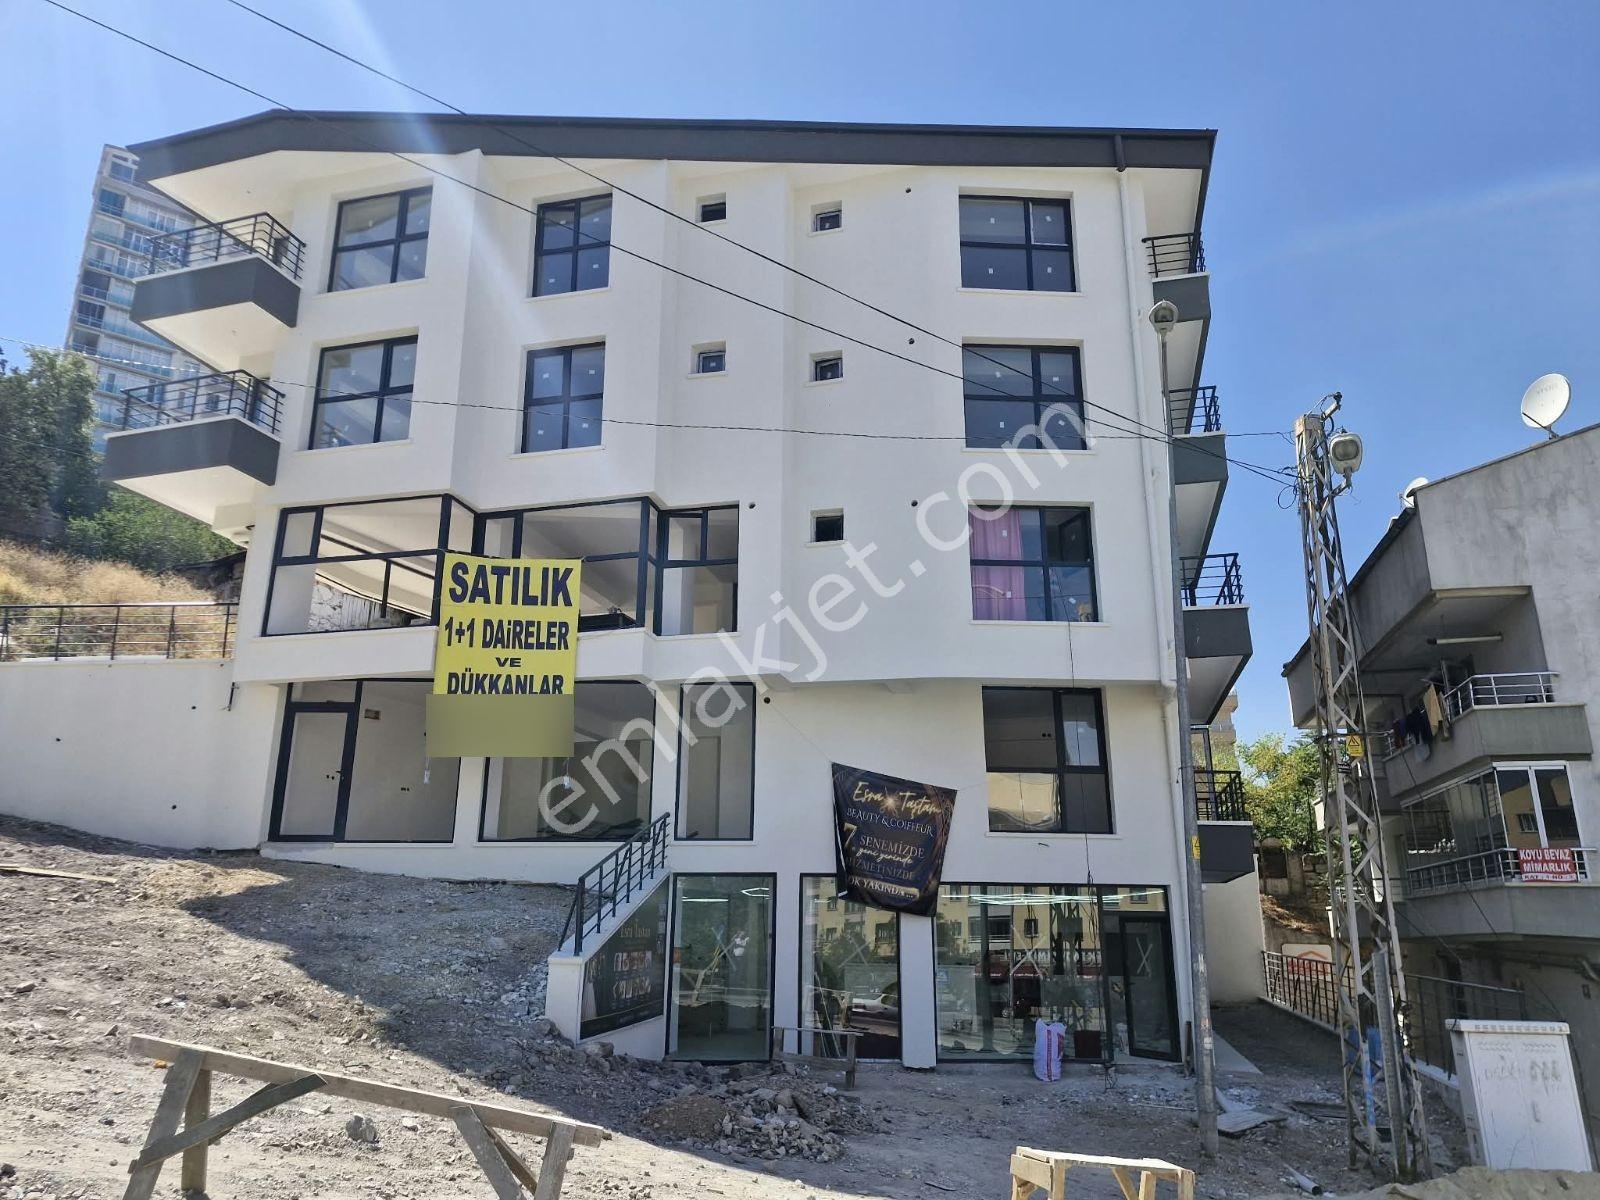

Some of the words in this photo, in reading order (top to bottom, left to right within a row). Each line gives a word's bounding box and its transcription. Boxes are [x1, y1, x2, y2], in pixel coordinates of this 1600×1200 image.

[449, 561, 574, 607] SATILIK
[444, 617, 475, 648] 1+1
[495, 657, 522, 668] VE
[447, 667, 564, 694] DÜKKANLAR
[852, 781, 885, 802] Esra
[846, 808, 879, 826] BEAUTY
[890, 818, 934, 837] COIFFEUR
[1519, 849, 1542, 860] KOYU
[1544, 849, 1571, 860] BEYAZ
[1523, 860, 1572, 872] MİMARLIK
